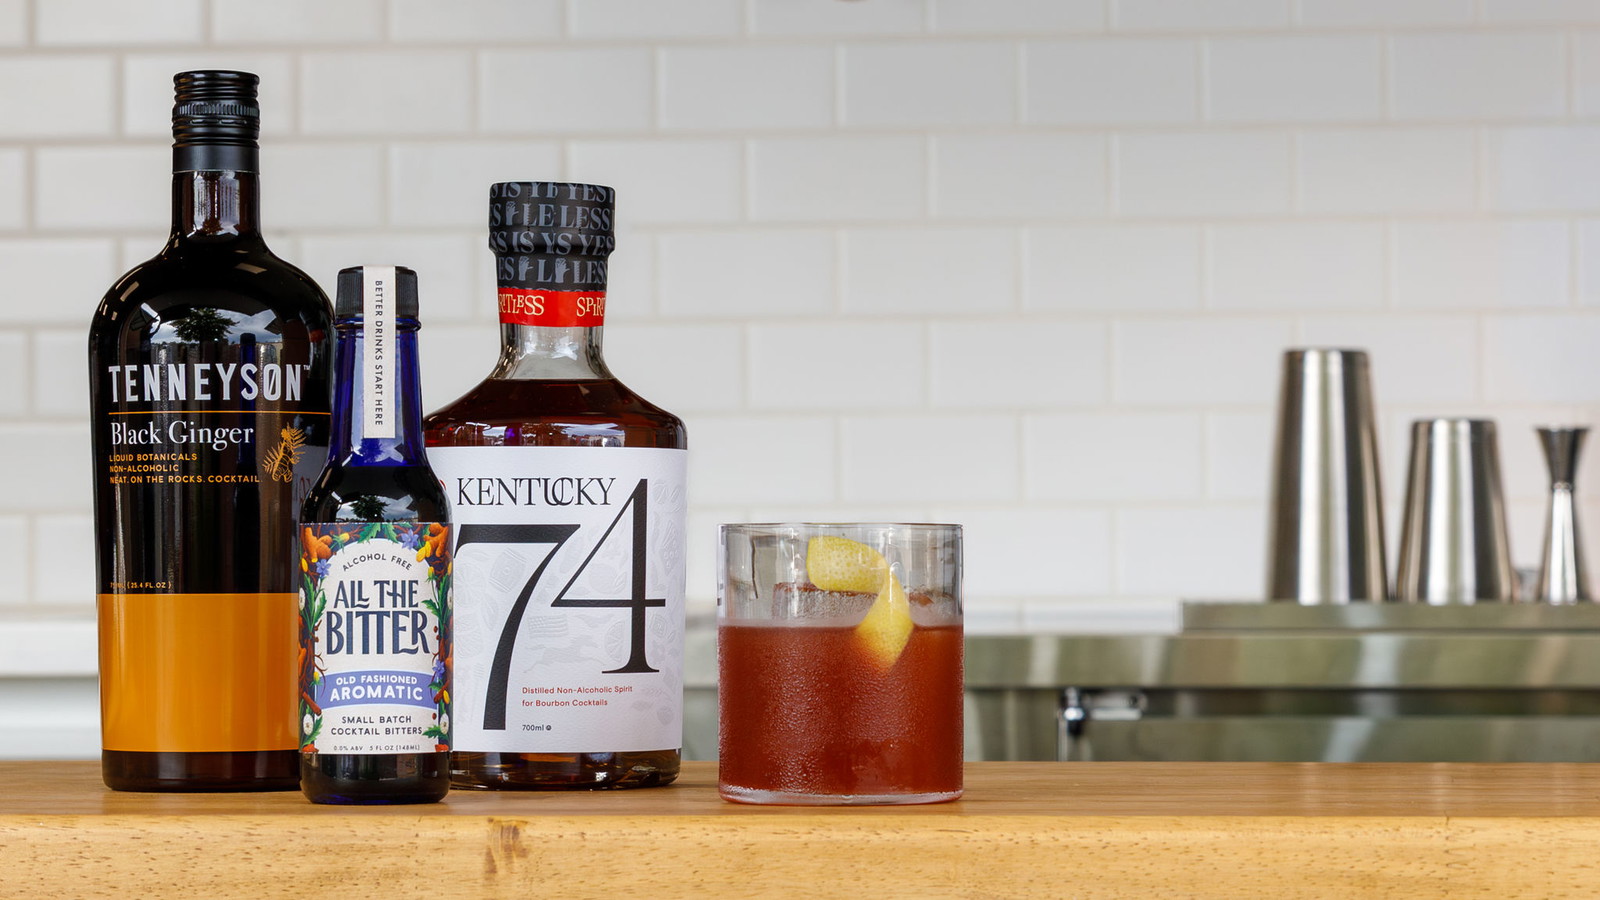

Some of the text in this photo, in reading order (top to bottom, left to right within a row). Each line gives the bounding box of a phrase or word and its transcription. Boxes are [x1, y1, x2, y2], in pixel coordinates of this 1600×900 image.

[560, 205, 611, 232] LESS
[512, 231, 535, 253] IS
[375, 280, 383, 426] BETTER DRINKS START HERE
[111, 420, 254, 451] Black Ginger
[109, 453, 198, 462] LIQUID BOTANICALS
[109, 464, 180, 473] NON-ALCOHOLIC
[146, 475, 164, 483] THE
[168, 475, 206, 483] ROCKS.
[457, 477, 616, 507] KENTUCKY
[342, 553, 413, 572] ALCOHOL FREE
[333, 579, 419, 609] ALL THE
[454, 478, 666, 731] 74
[326, 610, 430, 655] BITTER
[336, 675, 418, 686] OLD FASHIONED
[556, 686, 613, 694] Non-Alcoholic
[614, 685, 633, 694] Spirit
[329, 685, 423, 702] AROMATIC
[572, 699, 608, 707] Cocktails
[341, 715, 412, 724] SMALL BATCH
[330, 727, 423, 736] COCKTAIL BITTERS
